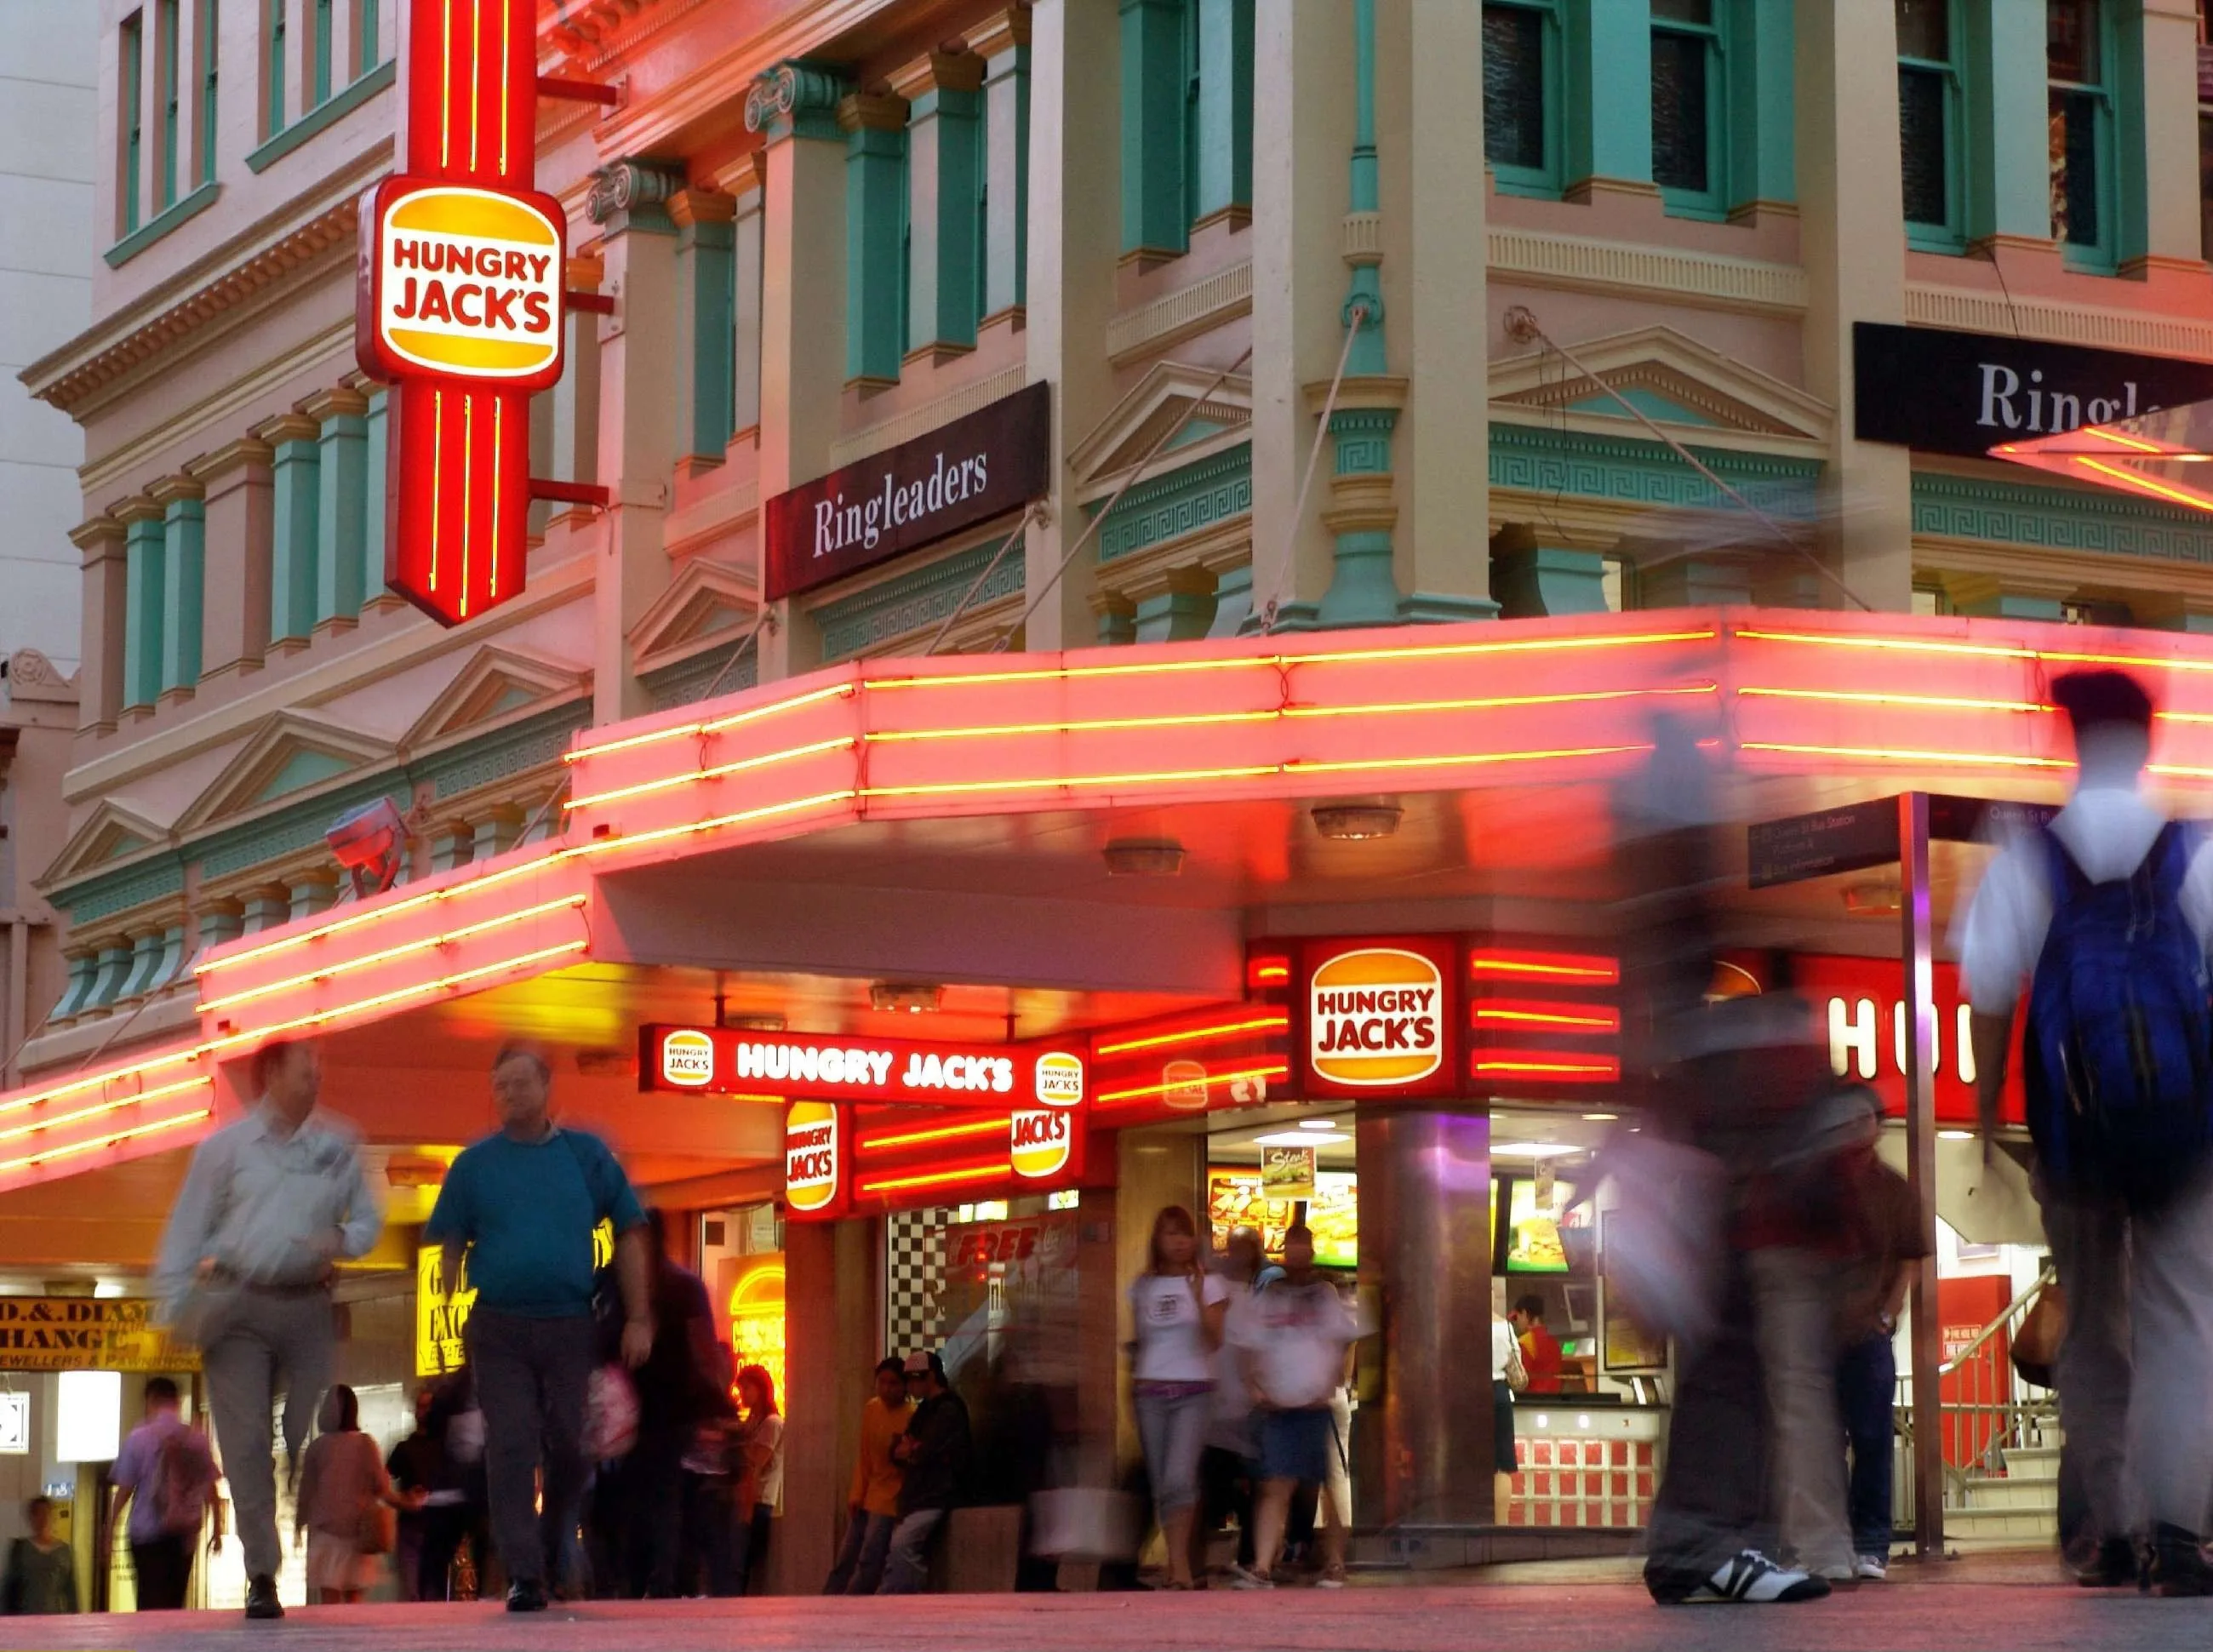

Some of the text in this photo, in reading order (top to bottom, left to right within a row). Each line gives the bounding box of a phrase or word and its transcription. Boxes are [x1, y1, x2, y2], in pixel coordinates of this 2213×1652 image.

[393, 238, 551, 283] HUNGRY
[393, 277, 551, 333] JACK'S
[1976, 363, 2162, 433] Ringl
[813, 453, 987, 558] Ringleaders
[1826, 814, 1856, 830] Station
[1317, 988, 1435, 1016] HUNGRY
[1318, 1015, 1435, 1052] JACK'S
[669, 1048, 708, 1056] HUNGRY
[669, 1058, 709, 1070] JACKS
[737, 1043, 1013, 1092] HUNGRY JACK'S
[1042, 1069, 1079, 1078] HUNGRY
[1043, 1079, 1079, 1091] JACKS
